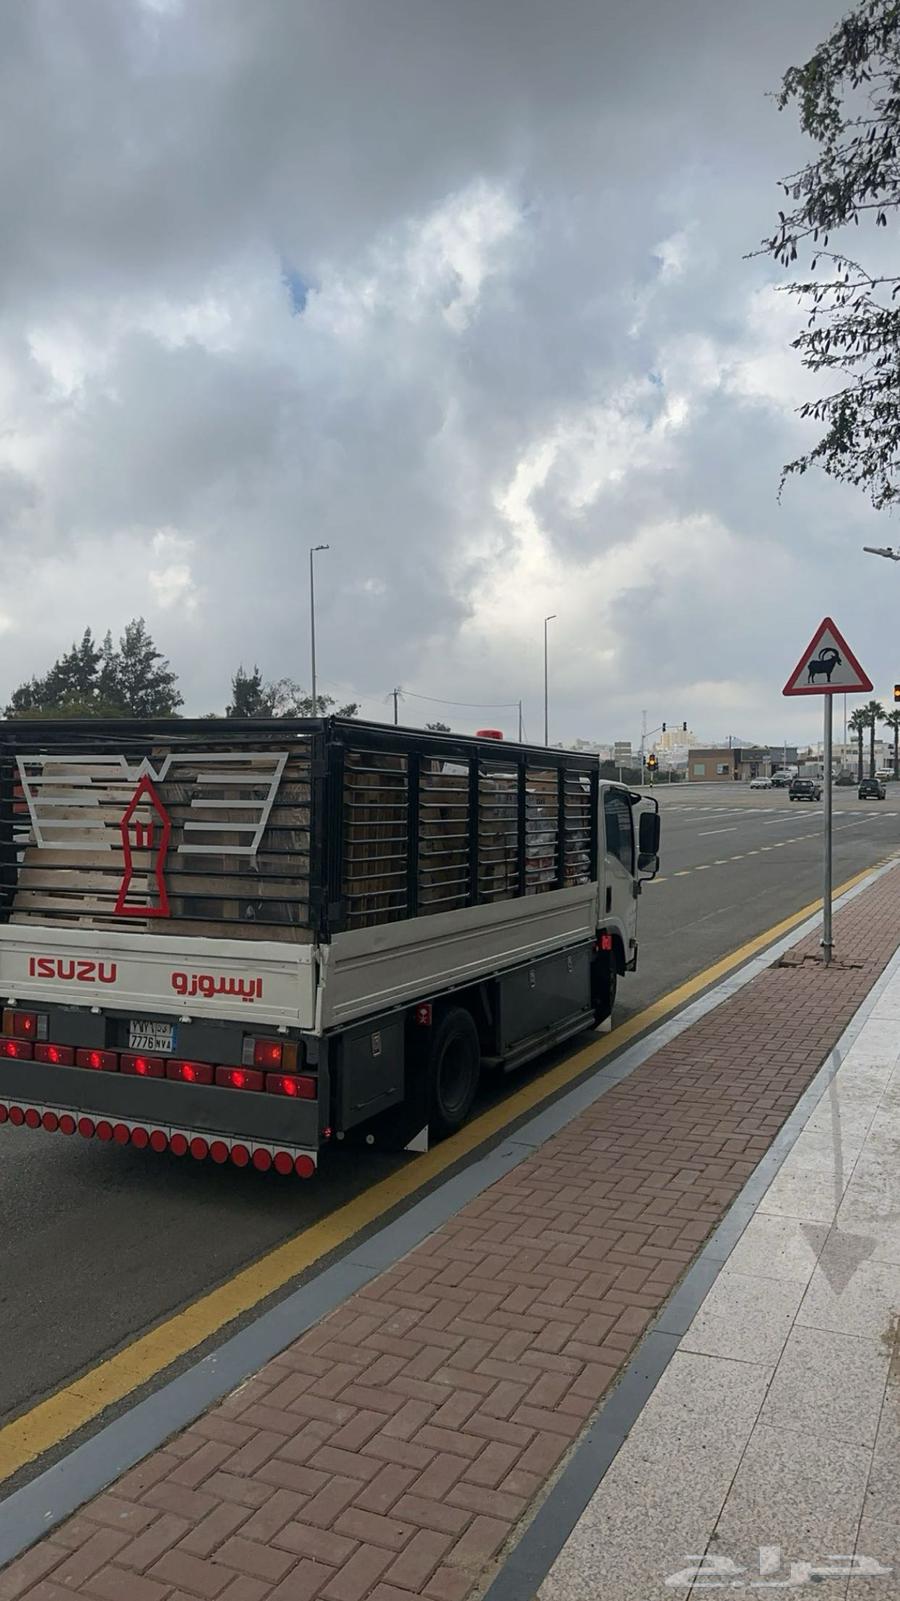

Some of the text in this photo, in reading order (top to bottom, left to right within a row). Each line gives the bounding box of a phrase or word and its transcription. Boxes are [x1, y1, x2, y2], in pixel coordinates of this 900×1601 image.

[29, 957, 117, 983] ISUZU
[172, 972, 263, 1002] ايسوزو
[132, 1035, 153, 1049] 7776
